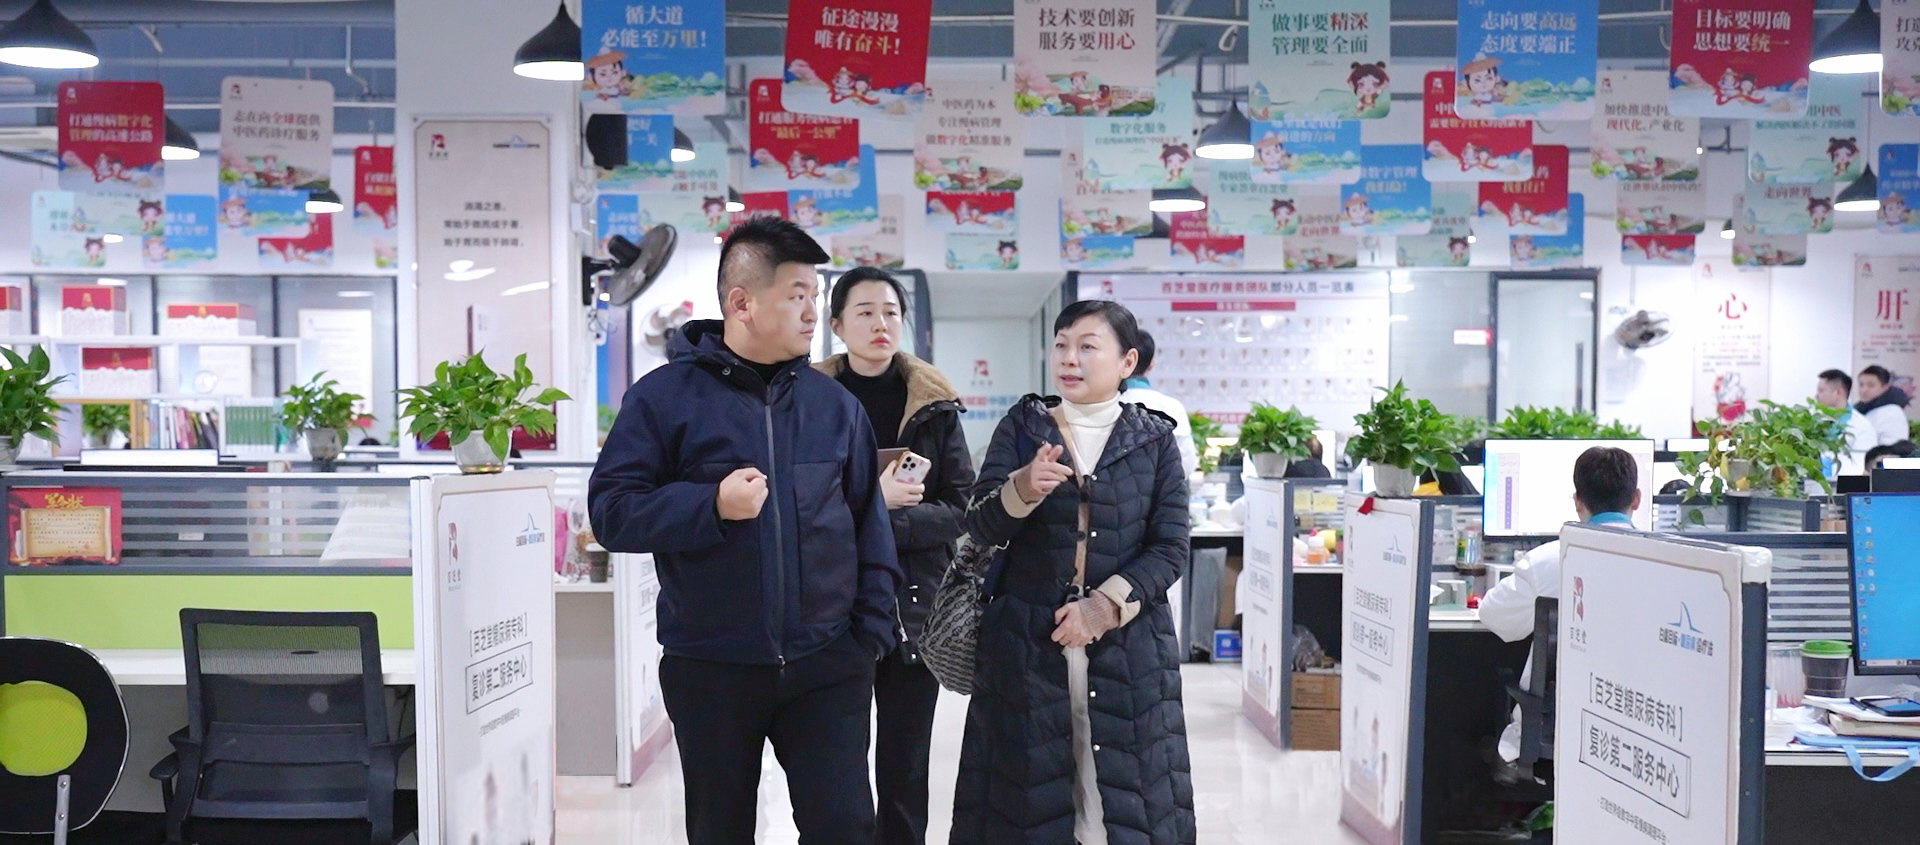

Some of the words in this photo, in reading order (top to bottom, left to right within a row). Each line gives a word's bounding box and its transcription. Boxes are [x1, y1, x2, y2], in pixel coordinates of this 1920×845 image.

[624, 5, 684, 26] 循大道
[821, 7, 900, 33] 征途漫漫
[1038, 8, 1135, 28] 技术要创新
[1272, 11, 1369, 32] 做事要精深
[1481, 11, 1577, 31] 志向要高远
[1695, 9, 1791, 30] 目标要明确
[814, 29, 901, 56] 唯有奋斗!
[1038, 31, 1136, 50] 服务要用心
[1272, 35, 1369, 55] 管理要全面
[1481, 34, 1576, 54] 态度要端正
[1693, 31, 1790, 52] 思想要统一
[942, 99, 996, 110] 中医药为本
[69, 113, 153, 128] 打通慢病数字化
[232, 111, 321, 126] 志在向全球提供
[1110, 122, 1167, 135] 数字化服务
[69, 128, 153, 143] 管理的高速公路
[232, 126, 321, 142] 中医药诊疗服务
[1161, 280, 1356, 295] 百芝堂医疗服务团队部分人员一览表
[1718, 291, 1748, 320] 心
[1875, 288, 1910, 321] 肝
[472, 653, 528, 702] 复诊第二服务中心
[1588, 725, 1680, 799] 复诊第二服务中心
